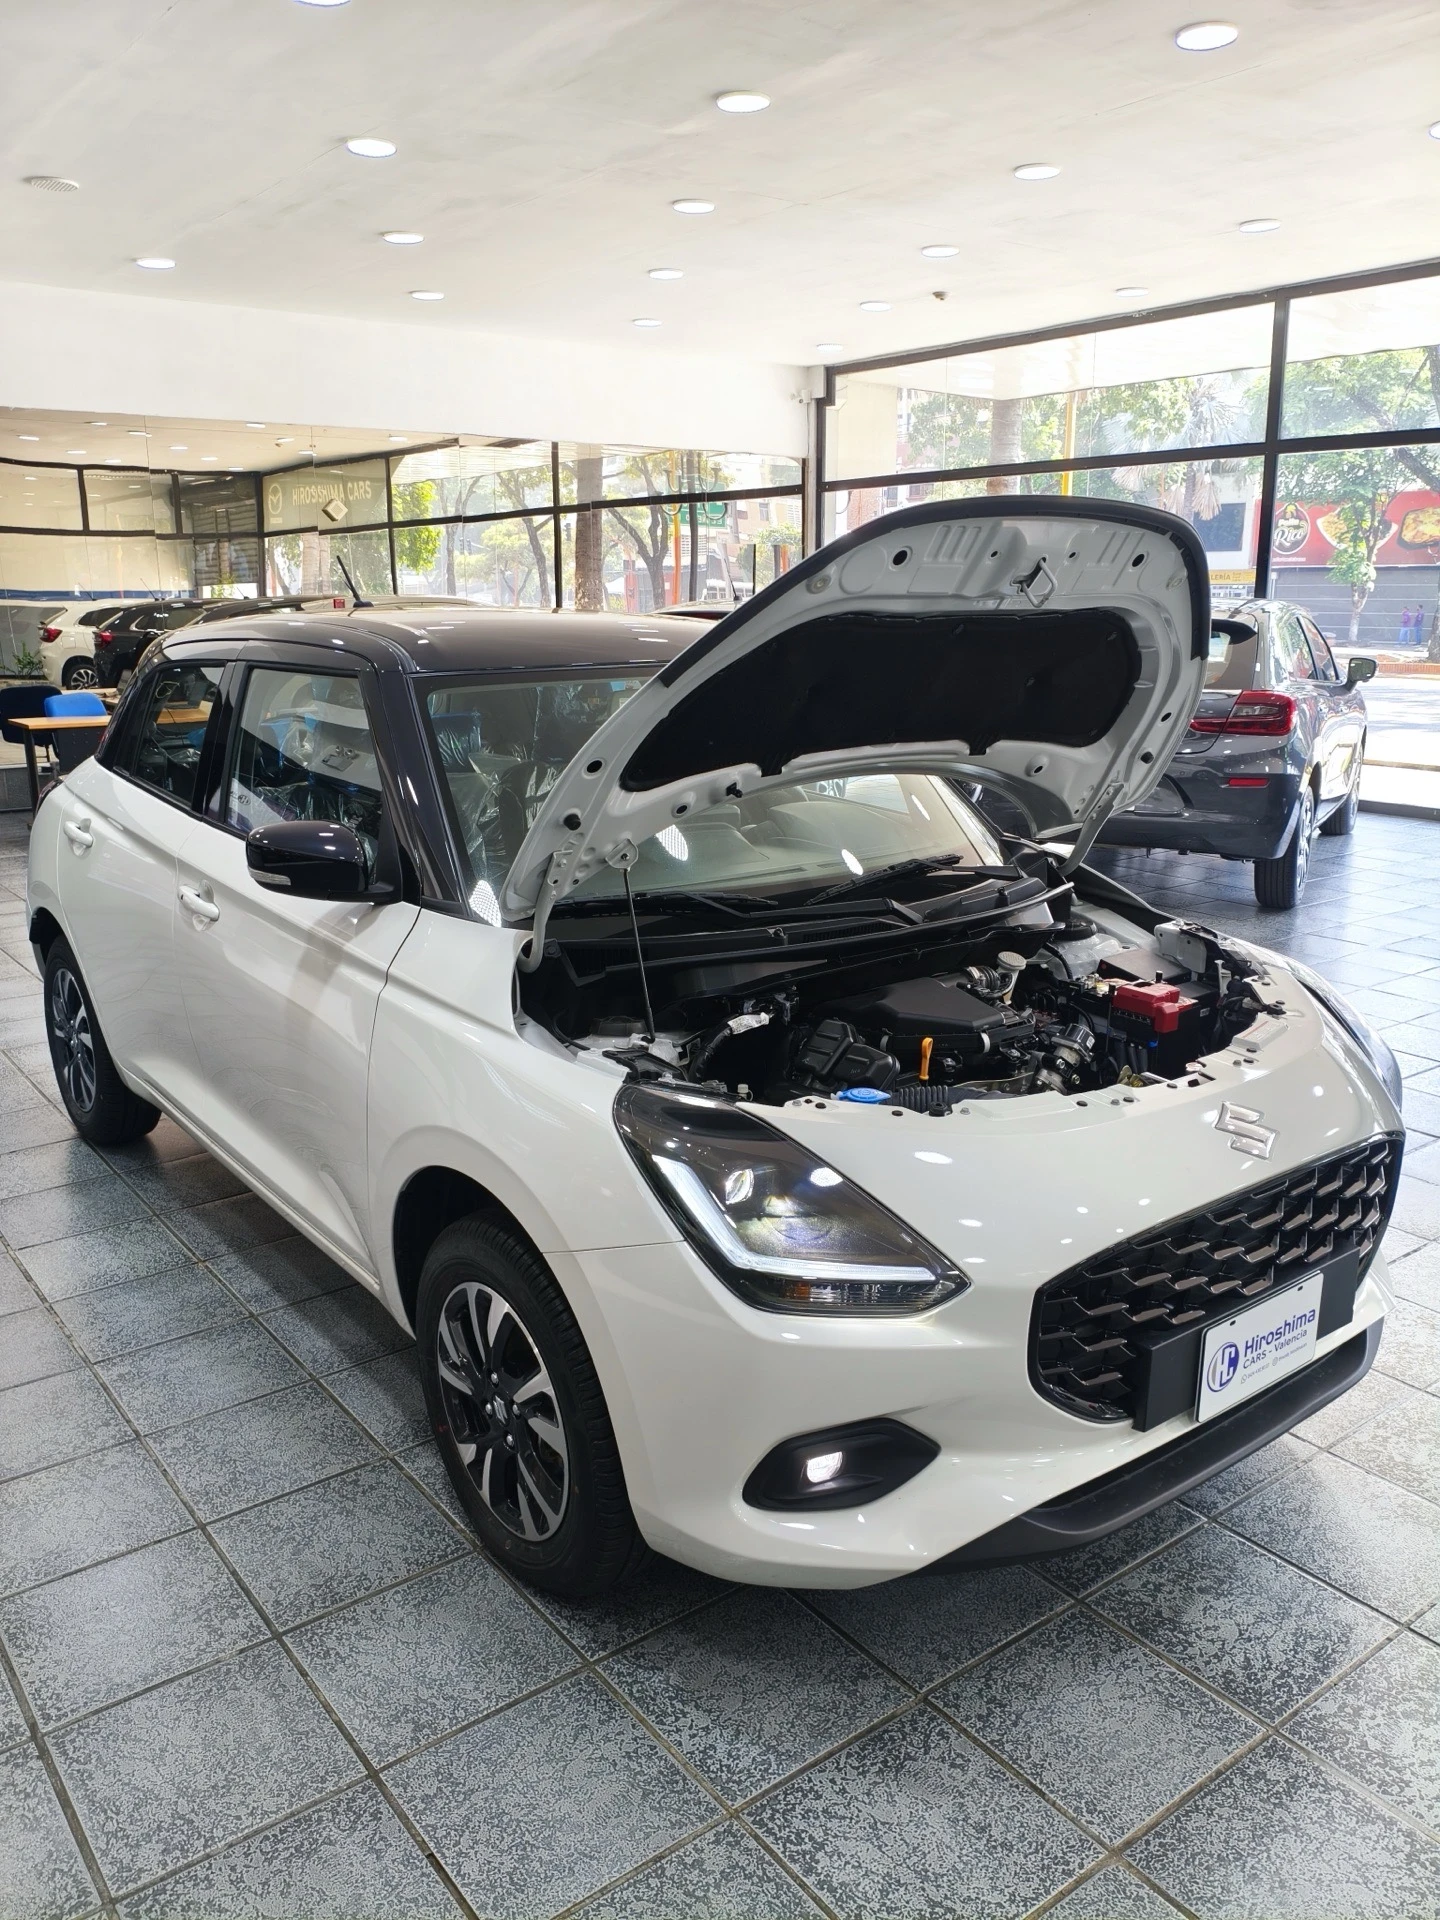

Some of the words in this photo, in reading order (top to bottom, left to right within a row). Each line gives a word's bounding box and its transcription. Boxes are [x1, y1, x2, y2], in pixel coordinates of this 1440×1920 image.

[347, 481, 372, 501] CARS
[1274, 526, 1305, 546] Rico
[1244, 1309, 1315, 1357] Hiroshima
[1243, 1349, 1267, 1369] CARS
[1274, 1329, 1308, 1352] Valencia
